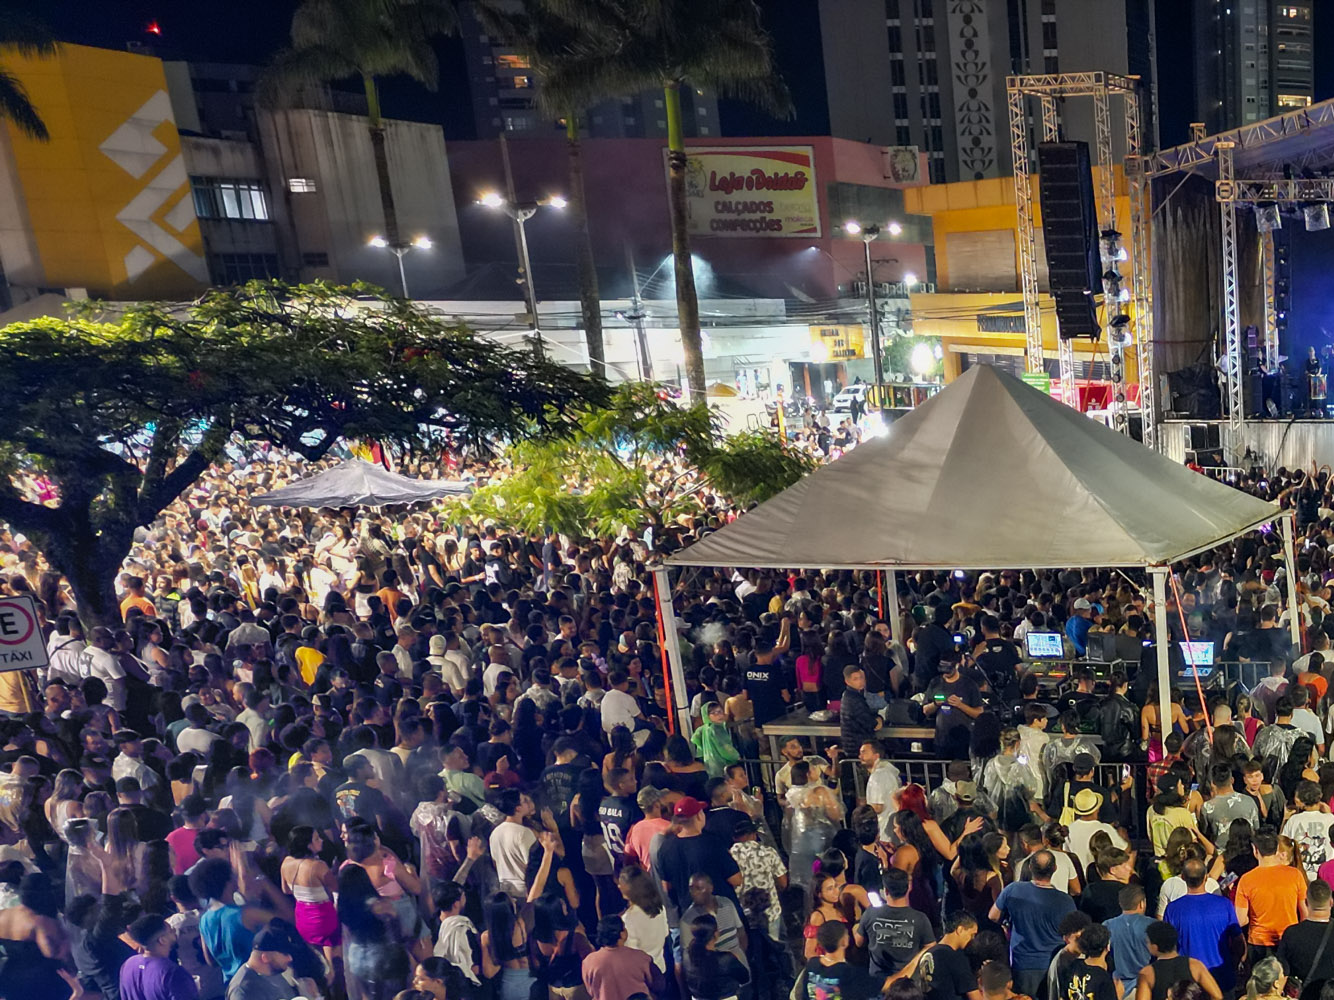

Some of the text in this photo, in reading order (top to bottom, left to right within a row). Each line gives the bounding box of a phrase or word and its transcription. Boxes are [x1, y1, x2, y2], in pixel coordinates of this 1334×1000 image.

[709, 170, 744, 195] Loja
[714, 200, 774, 215] CALÇADOS
[709, 217, 783, 232] CONFECÇÕES
